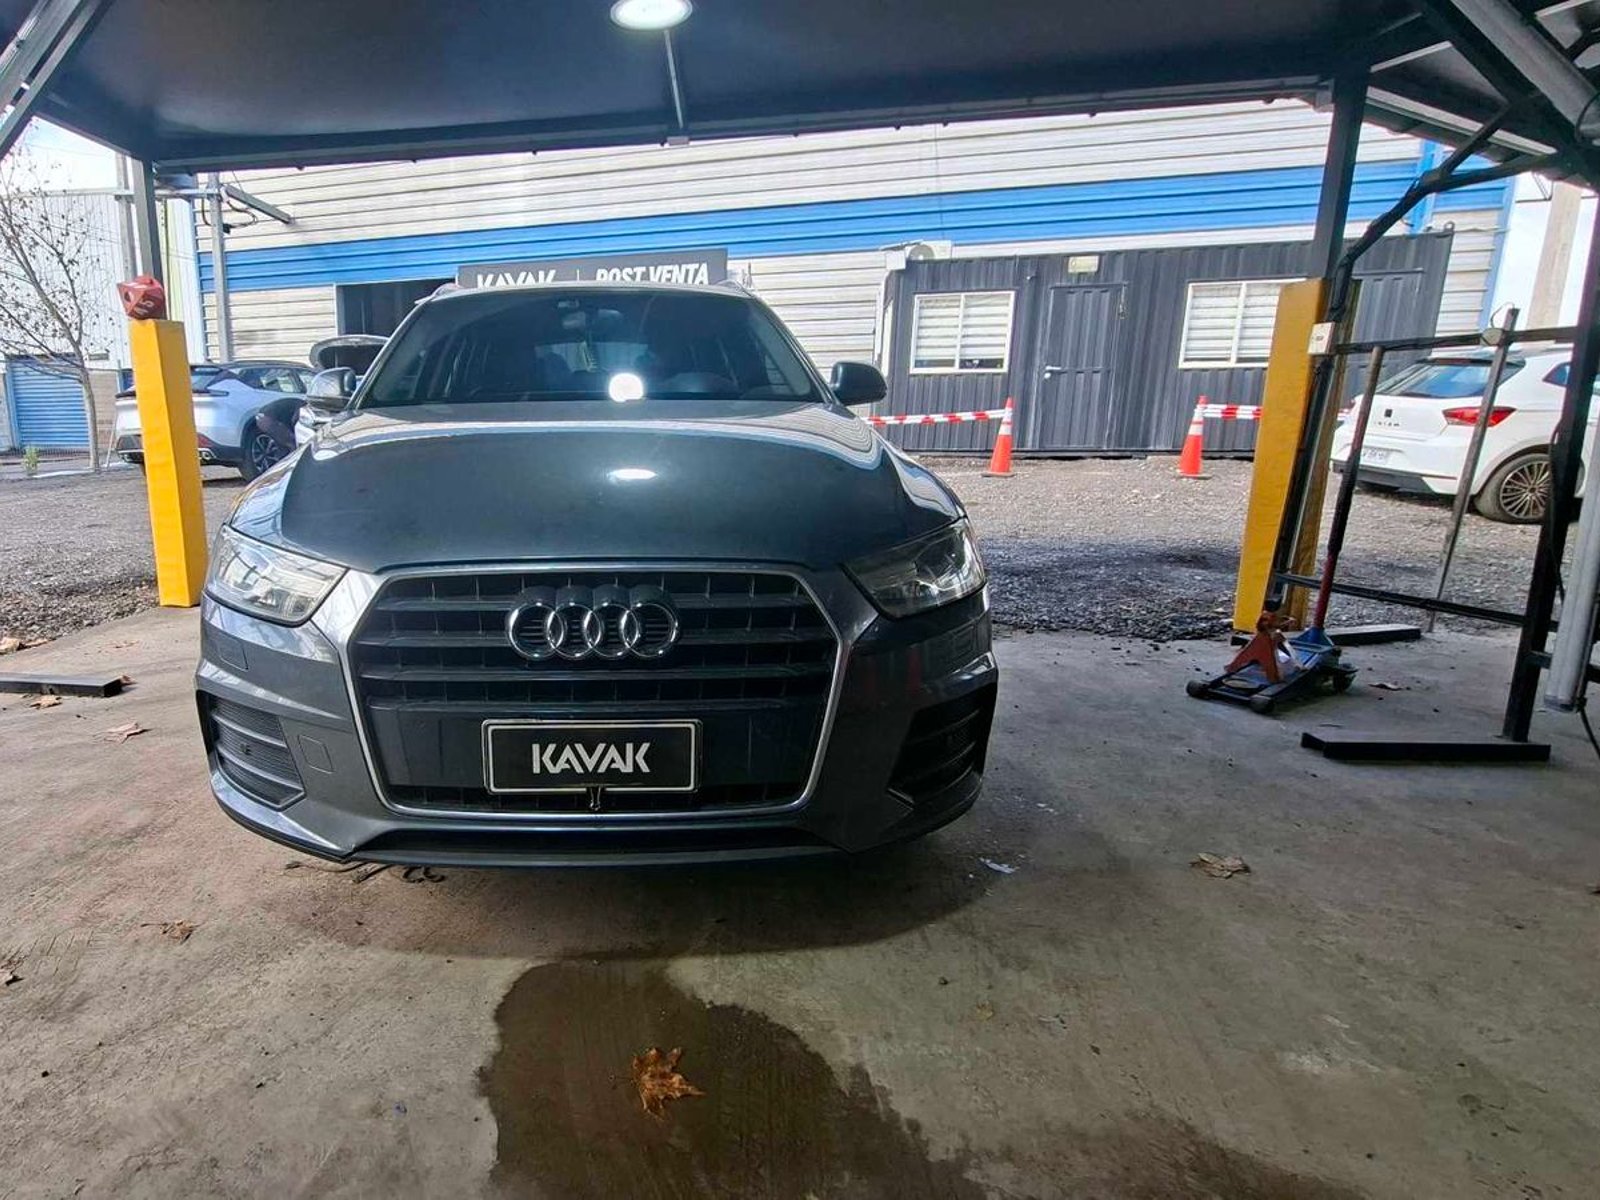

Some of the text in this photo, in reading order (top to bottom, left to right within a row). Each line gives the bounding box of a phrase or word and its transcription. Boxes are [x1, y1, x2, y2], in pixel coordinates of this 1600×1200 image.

[477, 269, 556, 288] KAVAK
[649, 262, 709, 285] VENTA
[532, 743, 650, 774] KAVAK
